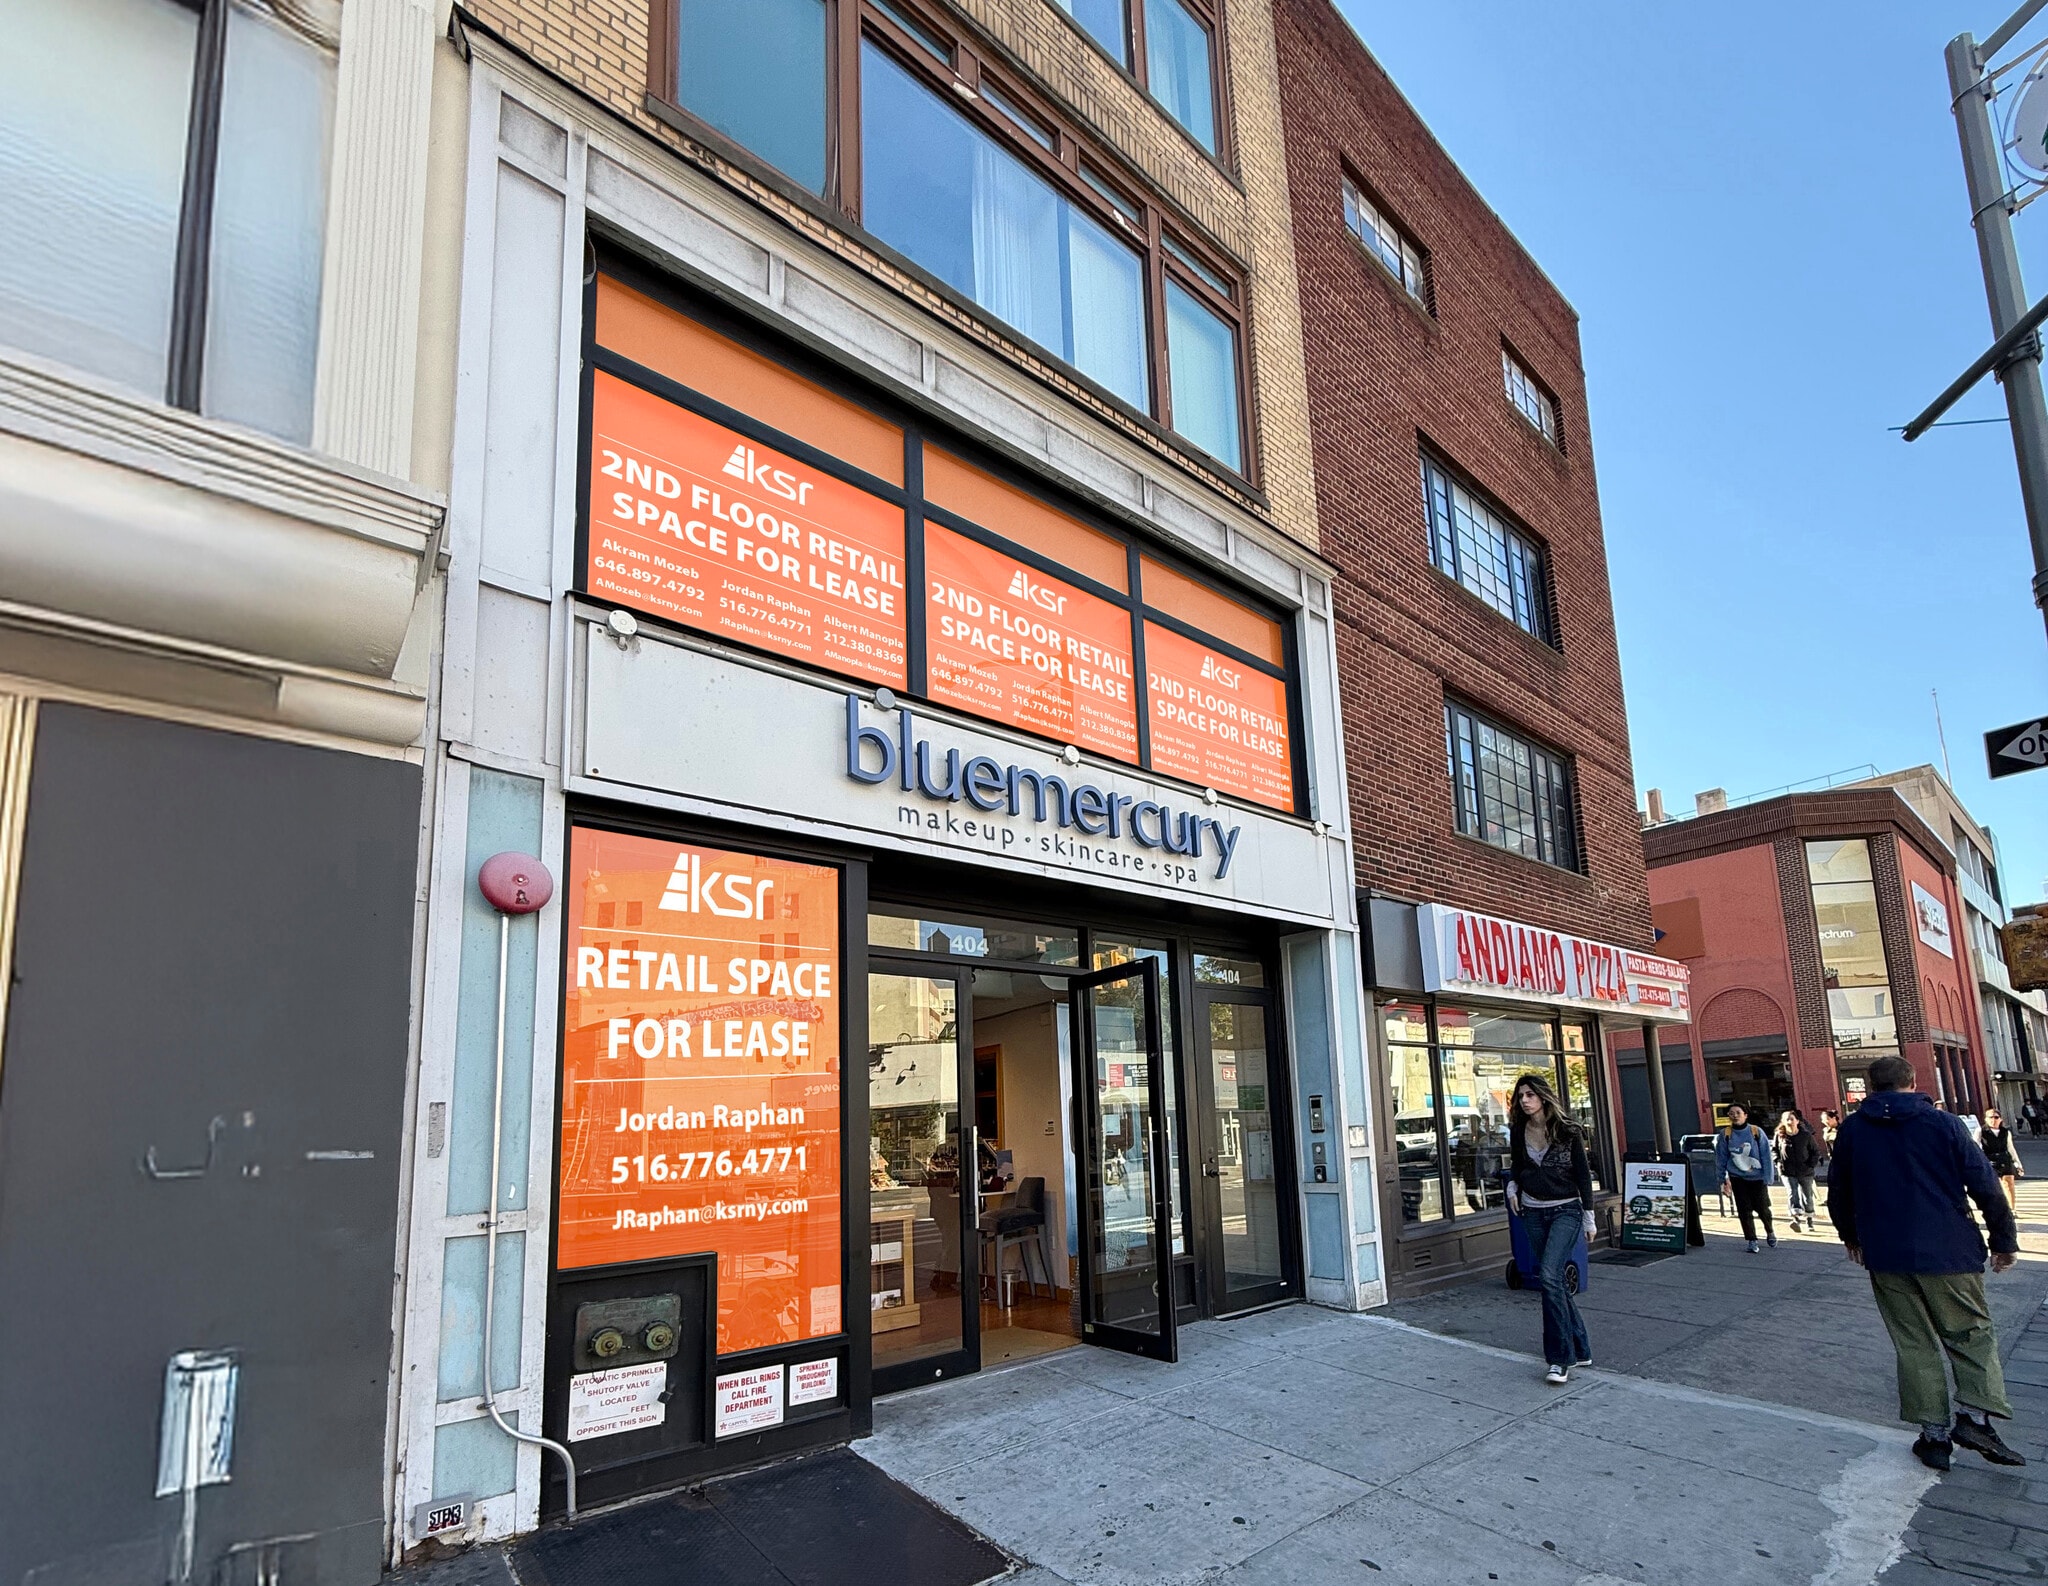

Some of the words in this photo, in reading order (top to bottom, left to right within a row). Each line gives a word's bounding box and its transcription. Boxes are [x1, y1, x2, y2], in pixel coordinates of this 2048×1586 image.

[601, 449, 682, 500] 2ND
[691, 483, 801, 549] FLOOR
[808, 531, 904, 589] RETAIL
[602, 538, 650, 563] Akram
[654, 555, 699, 579] Mozeb
[612, 491, 728, 556] SPACE
[736, 536, 801, 583] FOR
[808, 564, 895, 617] LEASE
[594, 556, 705, 601] 646.897.4792
[596, 577, 702, 618] AMozeb@ksrny.com
[721, 579, 764, 602] Jordan
[767, 594, 811, 618] Raphan
[719, 596, 812, 636] 516.776.4771
[823, 614, 857, 634] Albert
[860, 624, 904, 650] Manopla
[931, 581, 984, 618] 2ND
[988, 604, 1062, 652] FLOOR
[1066, 635, 1132, 680] RETAIL
[720, 616, 812, 652] JRaphan@ksrny.com
[823, 630, 904, 665] 212.380.8369
[936, 653, 967, 671] Akram
[968, 664, 998, 682] Mozeb
[940, 615, 1015, 661] SPACE
[1020, 644, 1063, 680] FOR
[1067, 663, 1128, 703] LEASE
[931, 666, 1003, 699] 646.897.4792
[1012, 680, 1041, 697] Jordan
[1042, 689, 1072, 708] Raphan
[1012, 694, 1073, 722] 516.776.4771
[1080, 703, 1103, 719] Albert
[1104, 712, 1135, 730] Manopla
[1150, 672, 1184, 699] 2ND
[1188, 687, 1238, 721] FLOOR
[1241, 706, 1287, 739] RETAIL
[1081, 718, 1136, 743] 212.380.8369
[1157, 699, 1207, 732] SPACE
[1209, 718, 1239, 744] FOR
[1242, 730, 1284, 759] LEASE
[846, 693, 1241, 880] bluemercury
[898, 805, 1015, 850] makeup
[1040, 833, 1145, 872] skincare
[1163, 861, 1199, 884] spa
[951, 934, 989, 955] 404
[1456, 912, 1566, 995] ANDIAMO
[1572, 940, 1630, 1003] PIZZA
[576, 946, 718, 993] RETAIL
[728, 957, 831, 998] SPACE
[1221, 968, 1240, 985] 404
[608, 1018, 692, 1059] FOR
[703, 1019, 810, 1058] LEASE
[615, 1105, 706, 1133] Jordan
[713, 1102, 805, 1133] Raphan
[611, 1146, 807, 1184] 516.776.4771
[612, 1198, 808, 1231] JRaphan@ksrny.com
[573, 1373, 619, 1387] AUTOMATIC
[621, 1366, 664, 1379] SPRINKLER
[718, 1380, 739, 1391] WHEN
[741, 1375, 757, 1386] BELL
[760, 1371, 780, 1382] RINGS
[796, 1369, 832, 1382] THROUGHOUT
[799, 1361, 829, 1373] SPRINKLER
[587, 1384, 624, 1397] SHUTOFF
[626, 1380, 650, 1390] VALVE
[600, 1394, 637, 1407] LOCATED
[731, 1390, 749, 1400] CALL
[751, 1385, 767, 1395] FIRE
[801, 1378, 826, 1390] BUILDING
[631, 1403, 651, 1413] FEET
[725, 1395, 773, 1414] DEPARTMENT
[576, 1421, 617, 1436] OPPOSITE
[620, 1418, 637, 1427] THIS
[638, 1414, 657, 1423] SIGN
